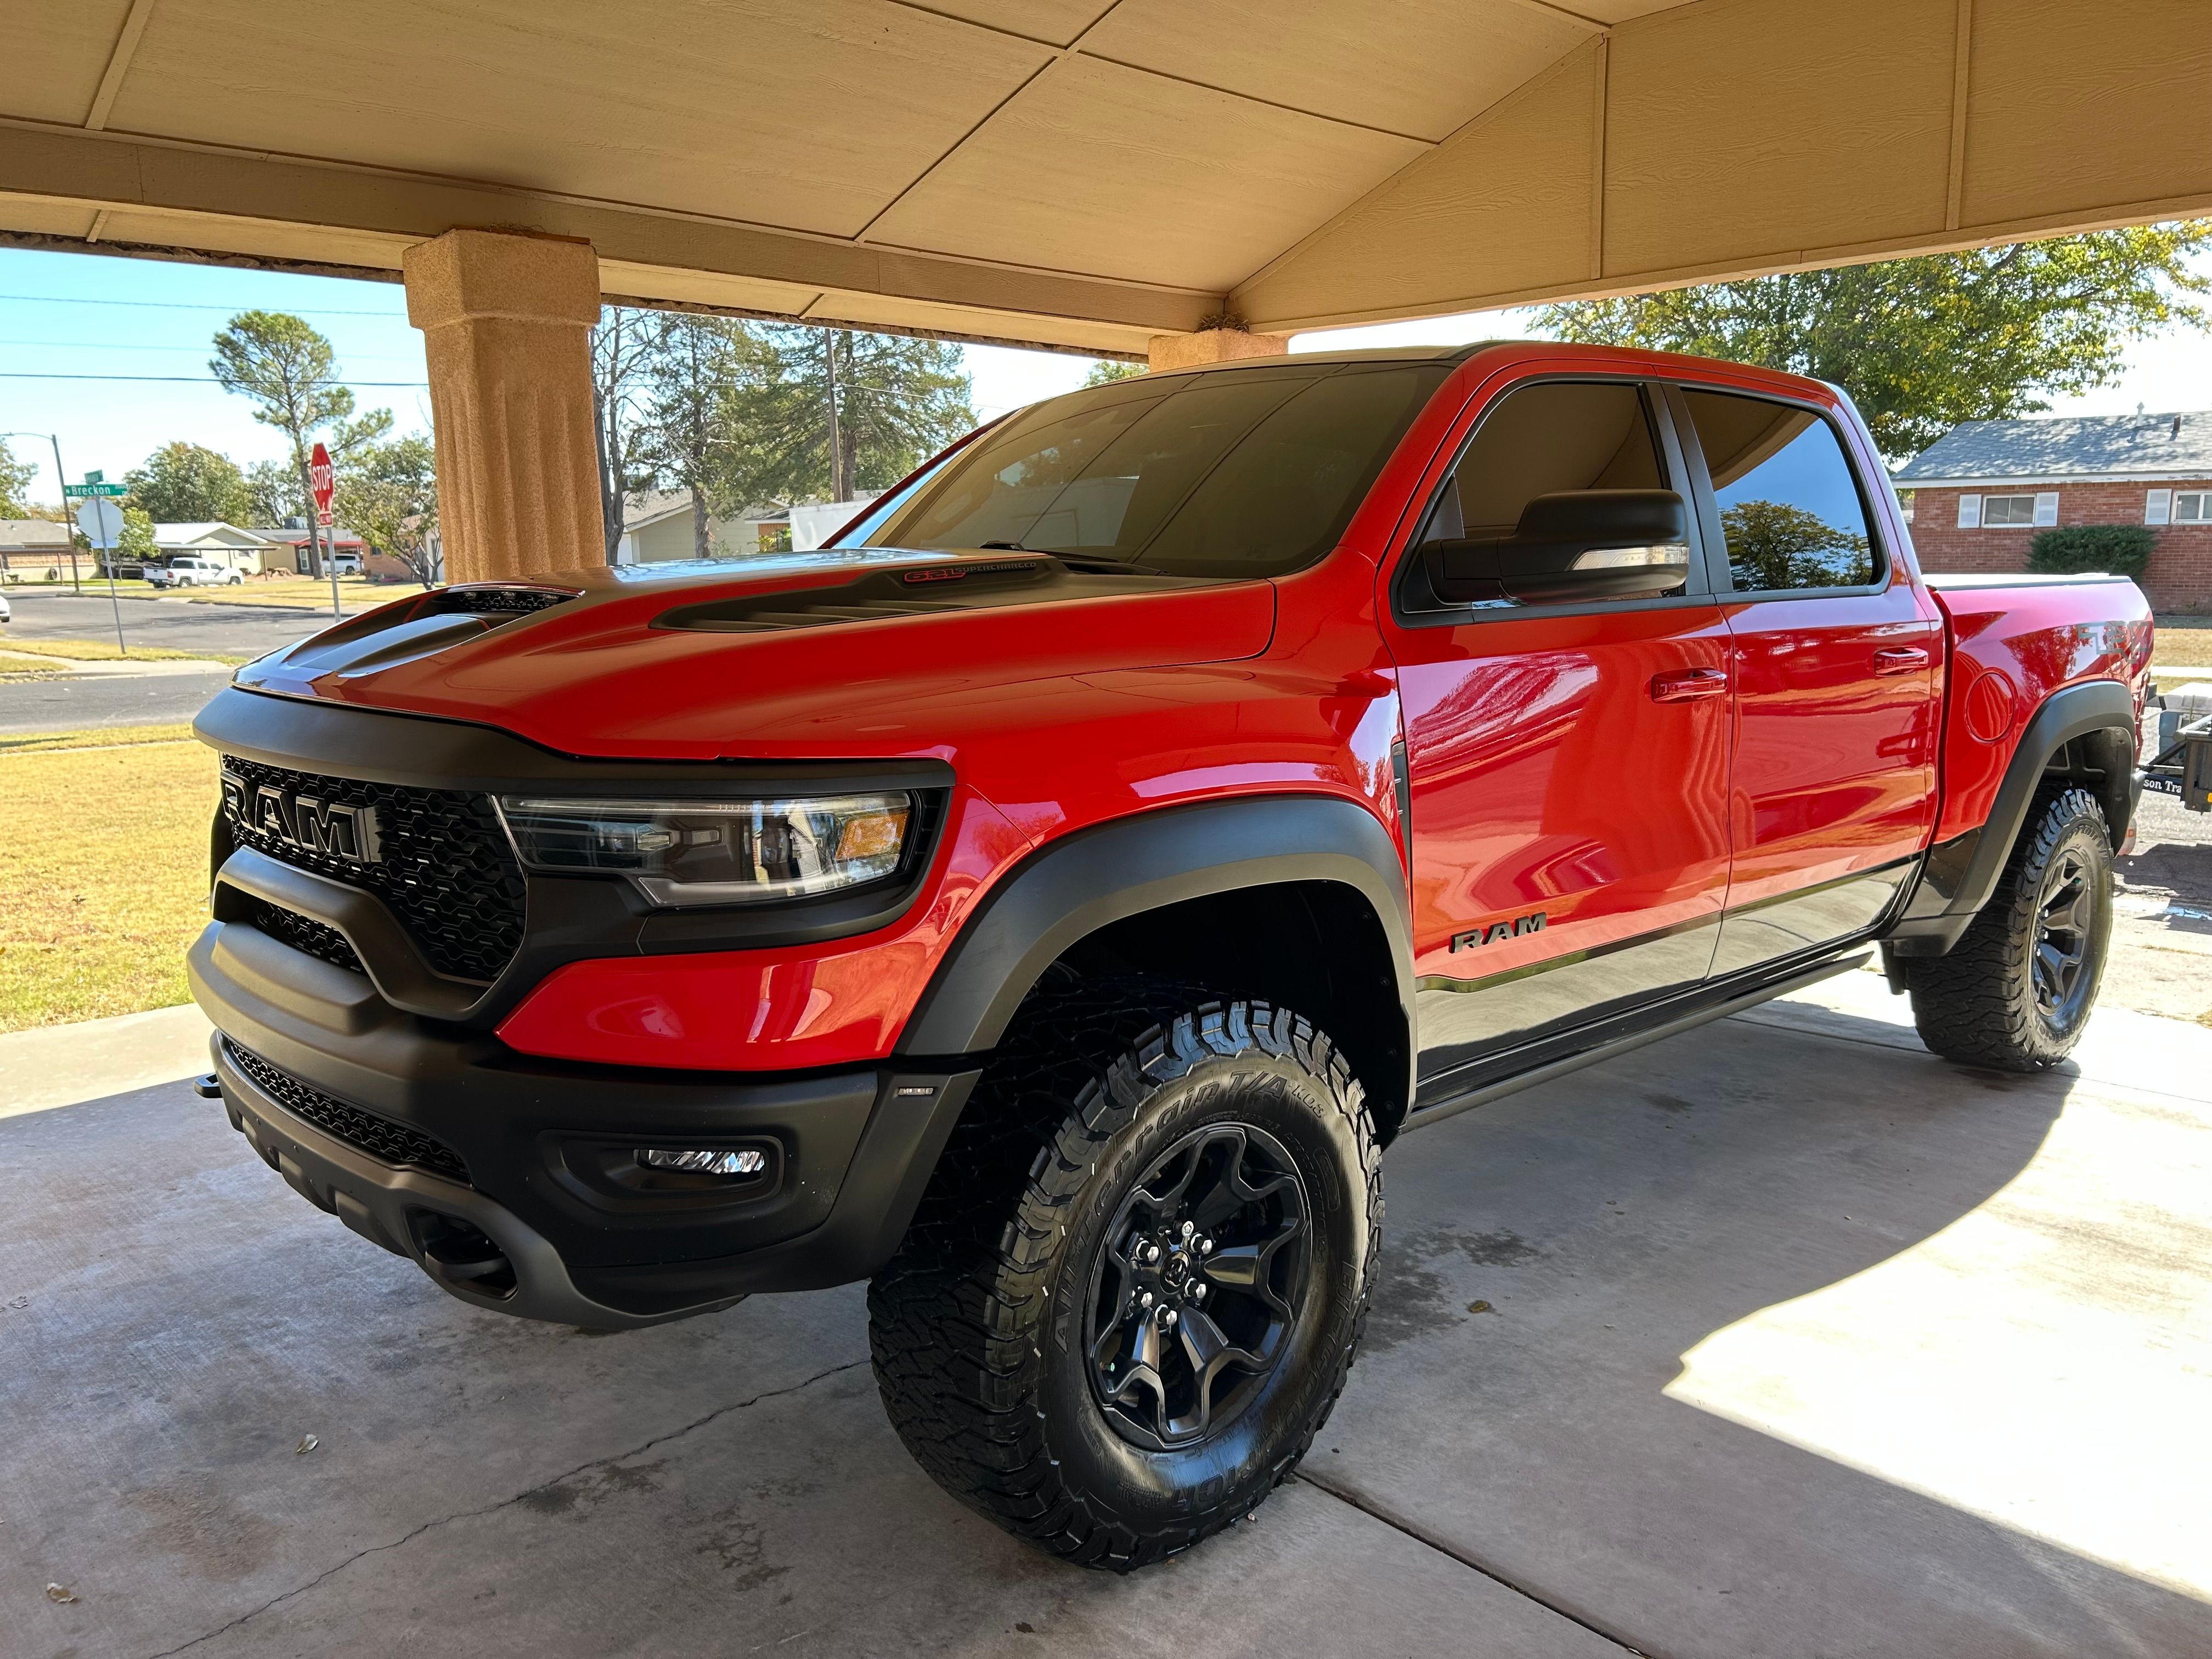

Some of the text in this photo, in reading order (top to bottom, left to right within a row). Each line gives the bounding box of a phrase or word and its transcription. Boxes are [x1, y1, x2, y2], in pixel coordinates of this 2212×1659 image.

[71, 486, 111, 495] Breckon
[312, 464, 331, 492] STOP
[955, 562, 1037, 573] SUPERCHARGED
[2143, 779, 2182, 793] son Tra
[220, 768, 369, 863] RAM
[1448, 912, 1547, 954] RAM
[1228, 1070, 1288, 1099] T/A
[1171, 1261, 1357, 1511] BFGoodrich
